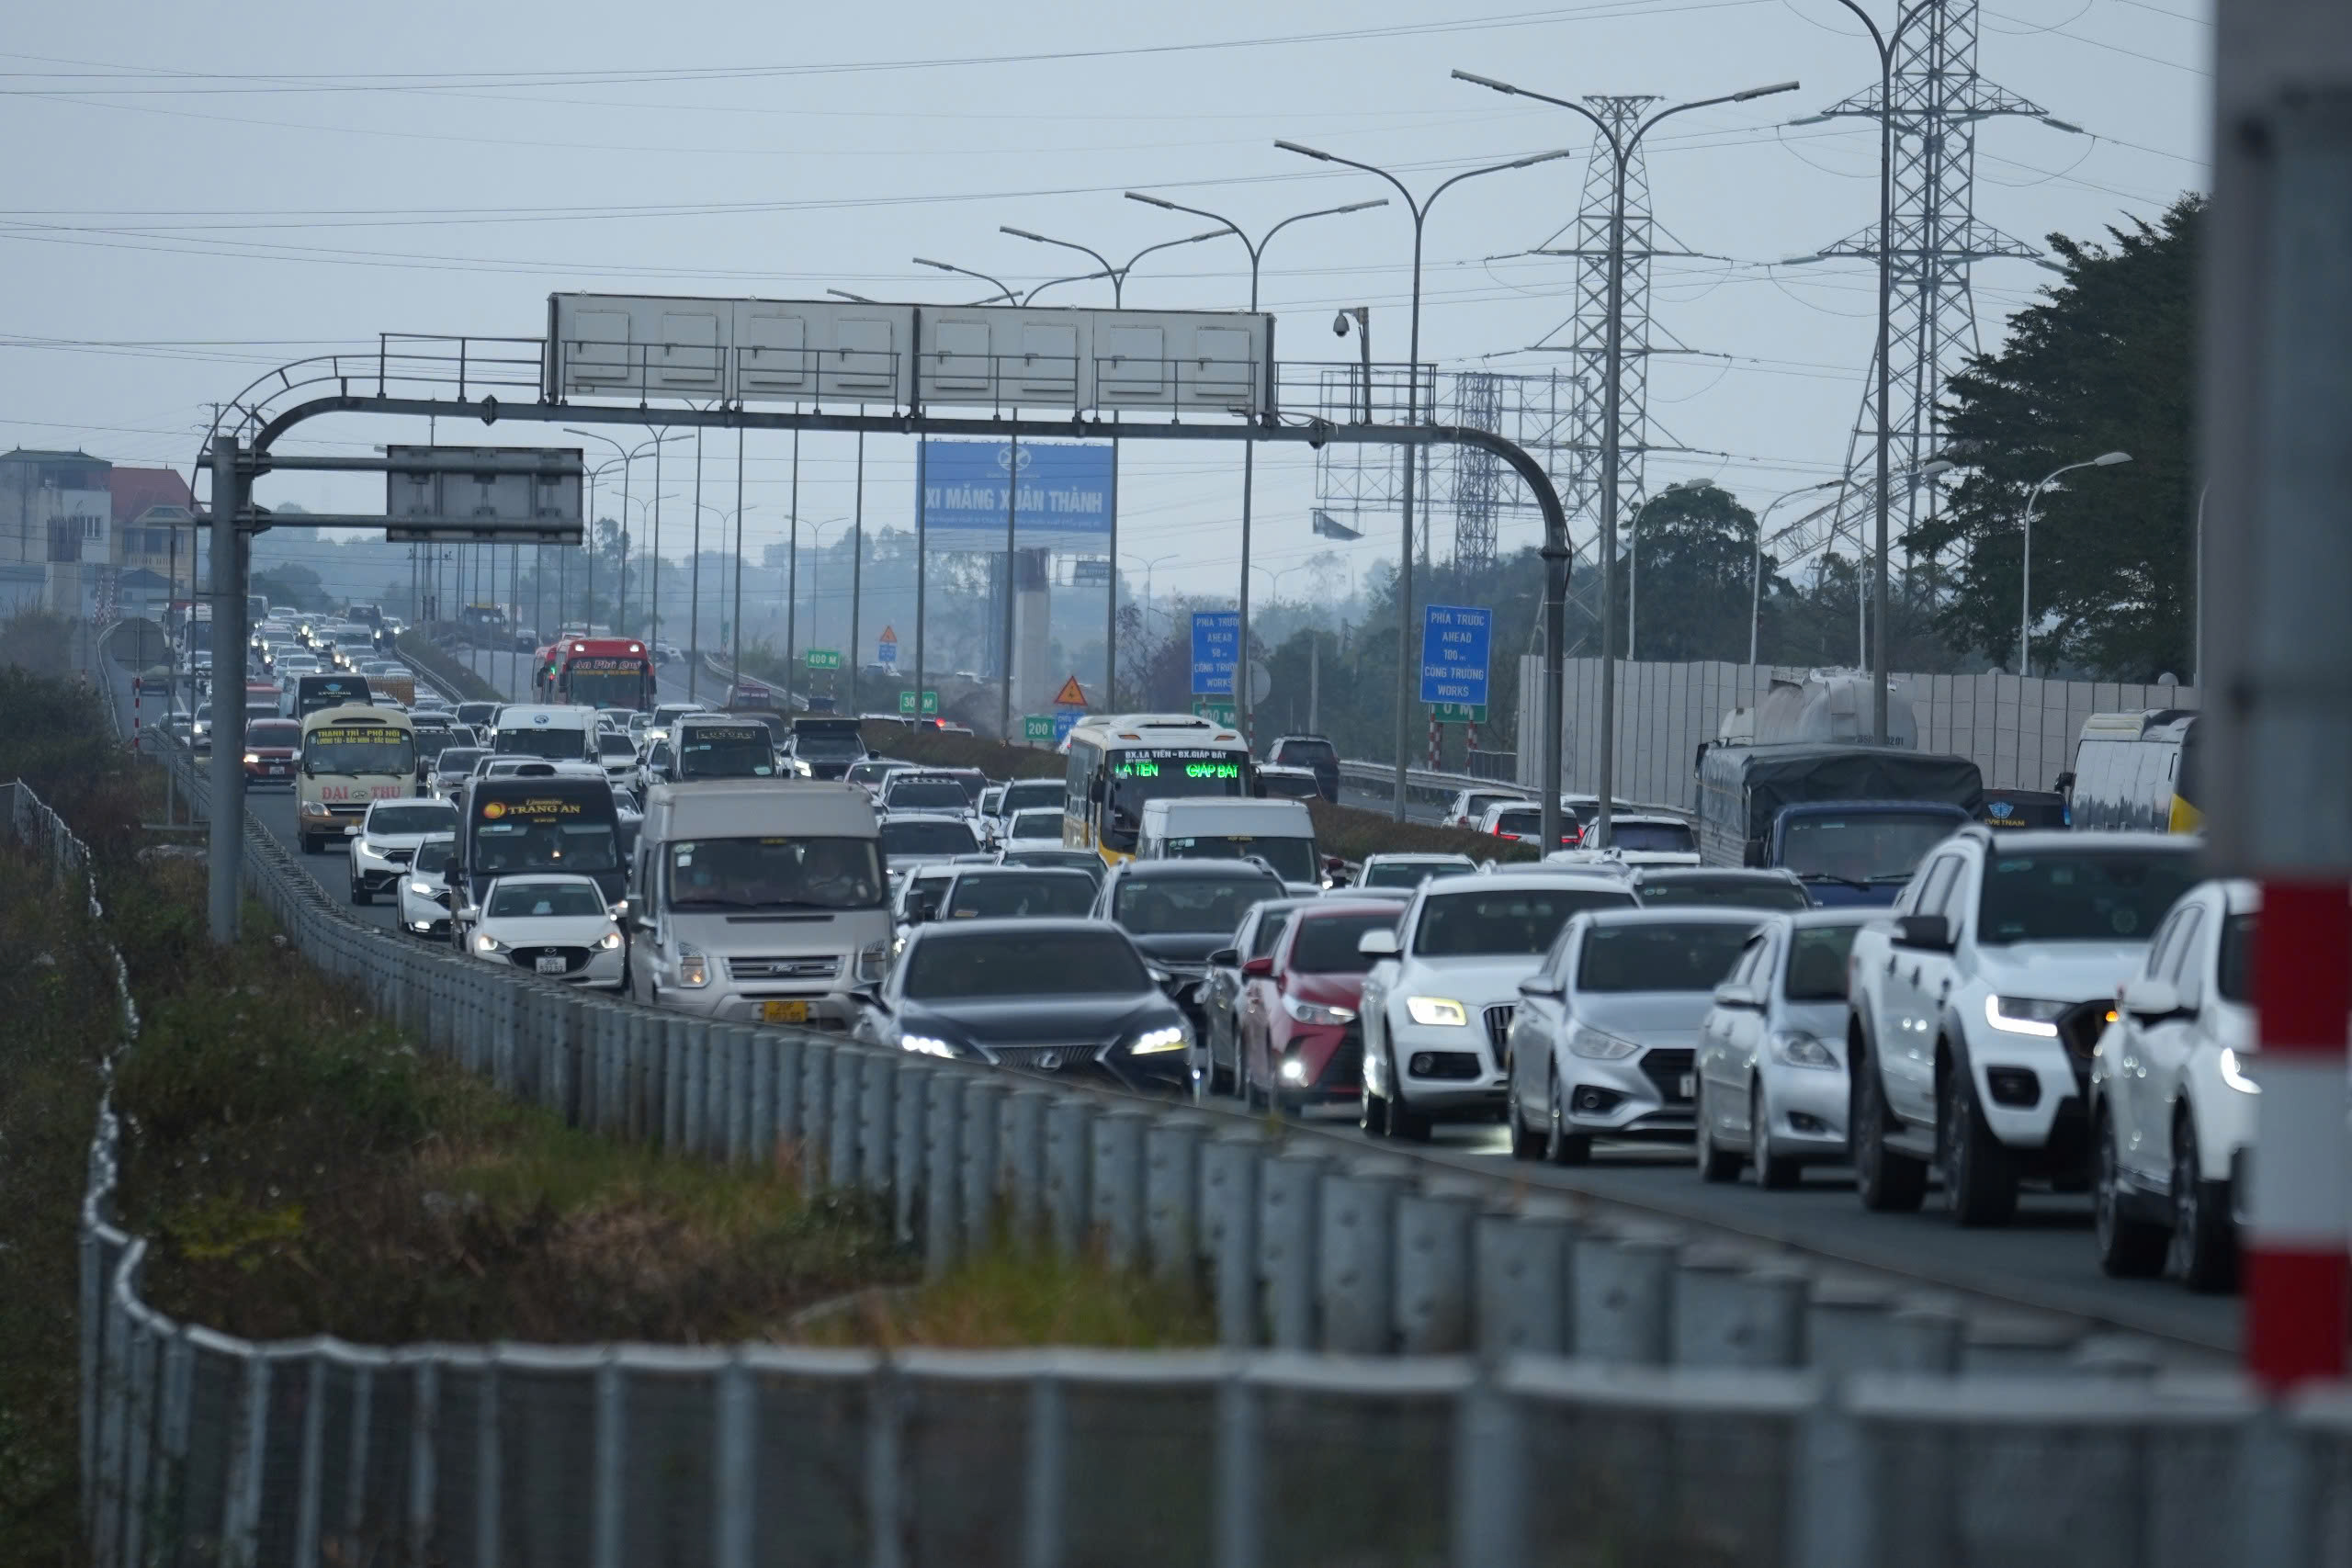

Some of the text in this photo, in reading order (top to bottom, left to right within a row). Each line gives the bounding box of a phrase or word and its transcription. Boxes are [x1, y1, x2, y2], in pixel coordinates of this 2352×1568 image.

[925, 487, 941, 509] XI
[1207, 632, 1233, 643] AHEAD
[1442, 631, 1472, 643] AHEAD
[809, 654, 837, 665] 400 M
[1443, 649, 1458, 661] 100
[1437, 684, 1470, 698] WORKS
[904, 696, 933, 709] 30 M
[318, 729, 345, 738] THANH
[1028, 721, 1048, 736] 200
